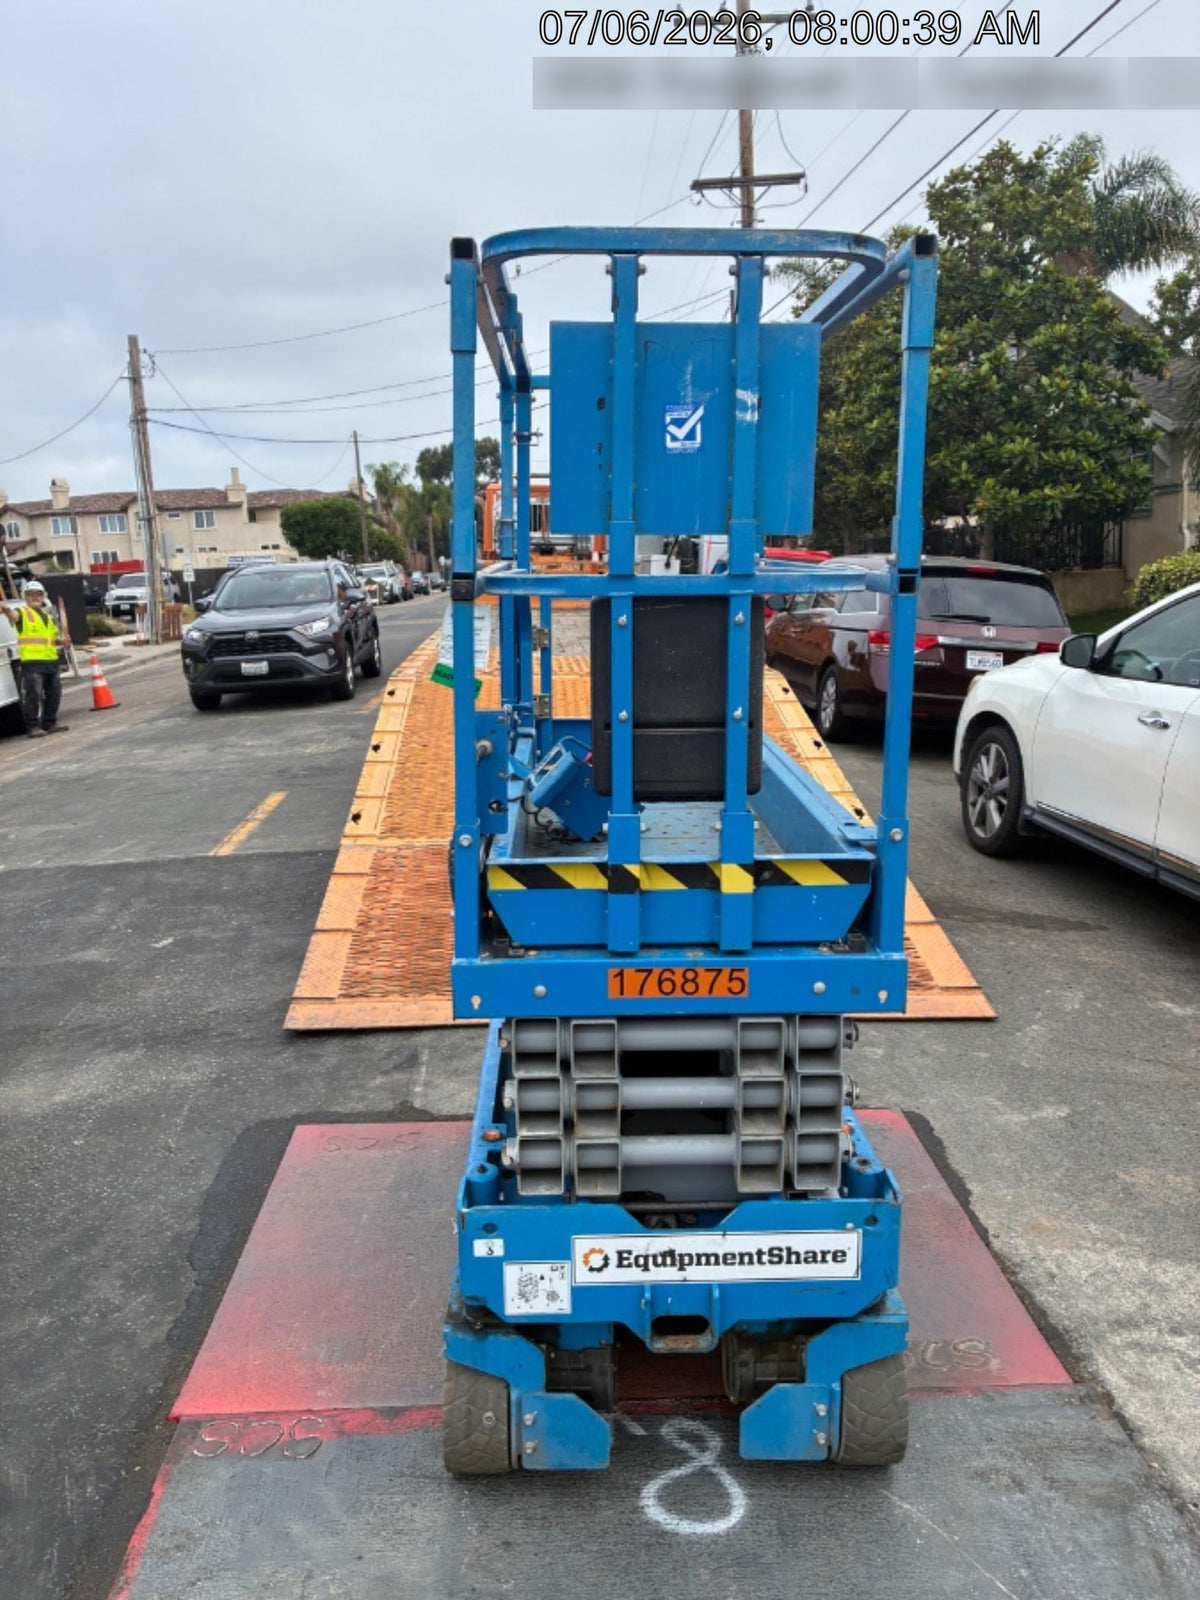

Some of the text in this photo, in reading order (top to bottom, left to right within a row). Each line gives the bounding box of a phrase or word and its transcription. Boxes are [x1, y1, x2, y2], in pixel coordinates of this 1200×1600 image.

[612, 967, 747, 997] 176875
[615, 1245, 848, 1272] EquipmentShare
[192, 1415, 325, 1460] SDS
[638, 1415, 749, 1536] 8
